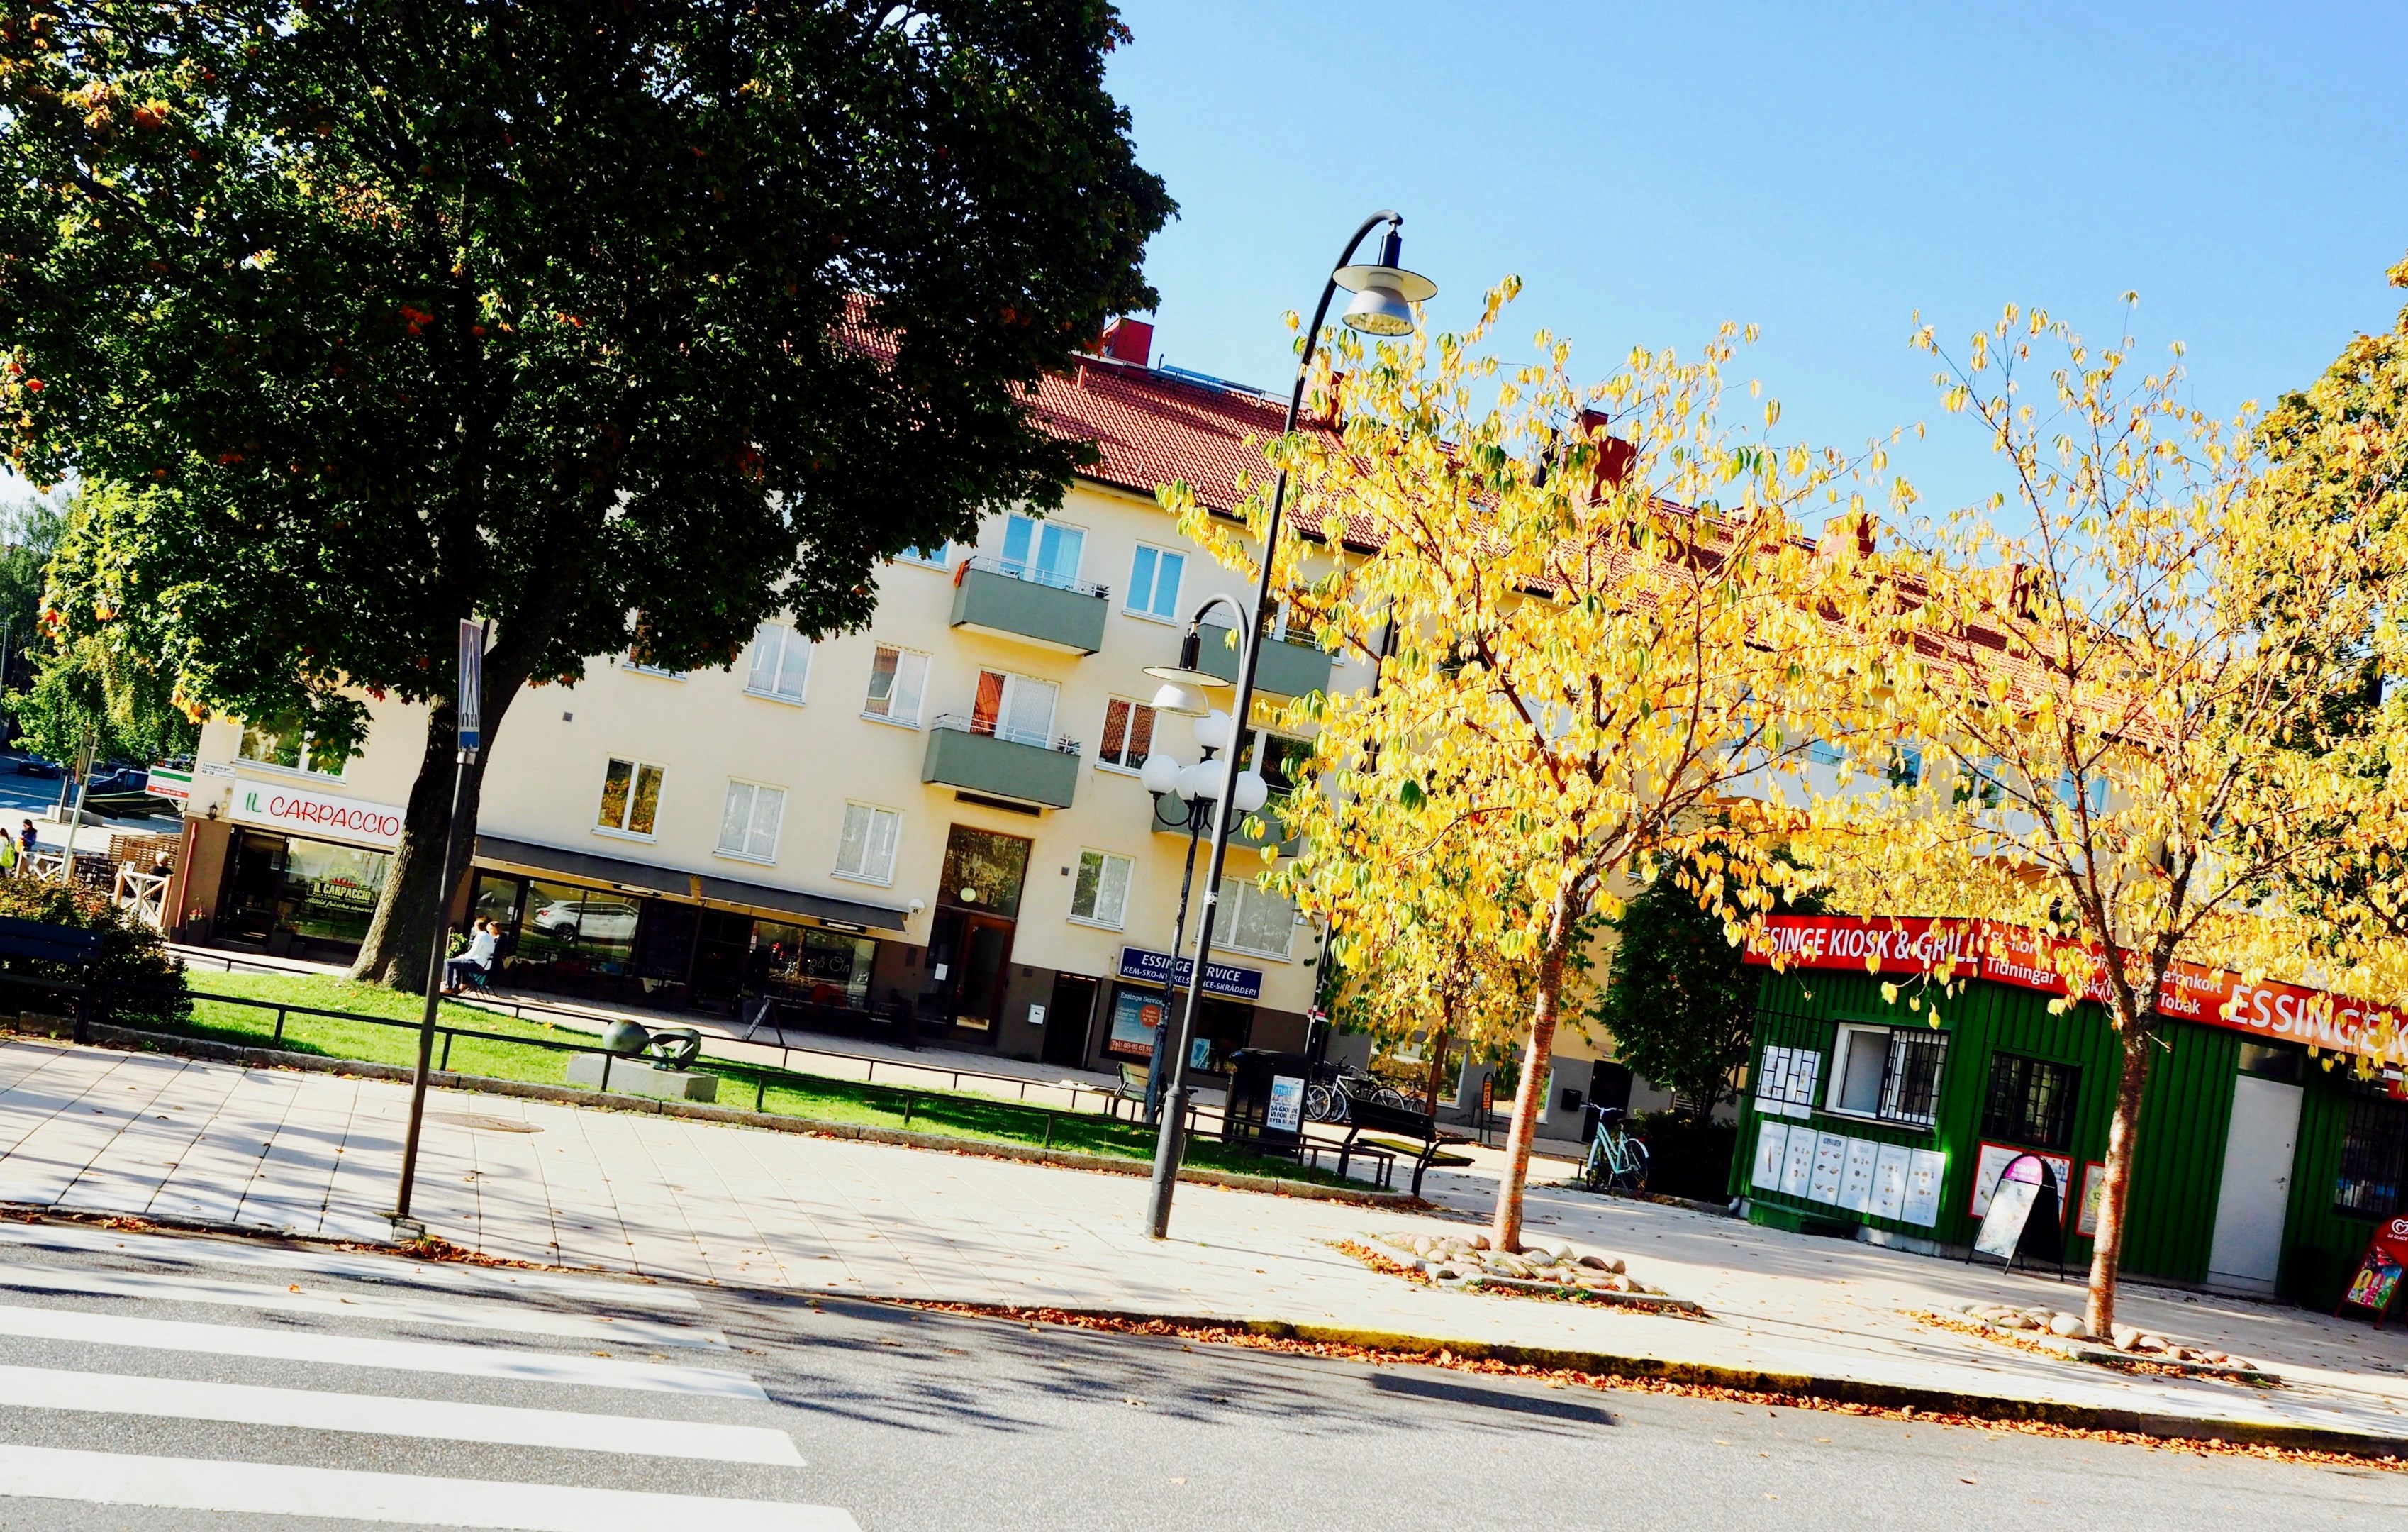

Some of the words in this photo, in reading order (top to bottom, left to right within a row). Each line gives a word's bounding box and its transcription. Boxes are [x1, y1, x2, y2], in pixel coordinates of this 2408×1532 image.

[245, 792, 262, 813] IL
[269, 796, 399, 837] CARPACCIO
[313, 882, 321, 893] IL
[323, 883, 371, 901] CARPACCIO
[1829, 928, 1893, 960] KIOSK
[1894, 930, 1912, 960] &
[1916, 931, 1978, 963] GRILL
[1120, 992, 1142, 1002] Essinge
[1986, 956, 2057, 986] Tidningar
[2159, 991, 2201, 1015] Tobak
[2228, 984, 2381, 1052] ESSINGE
